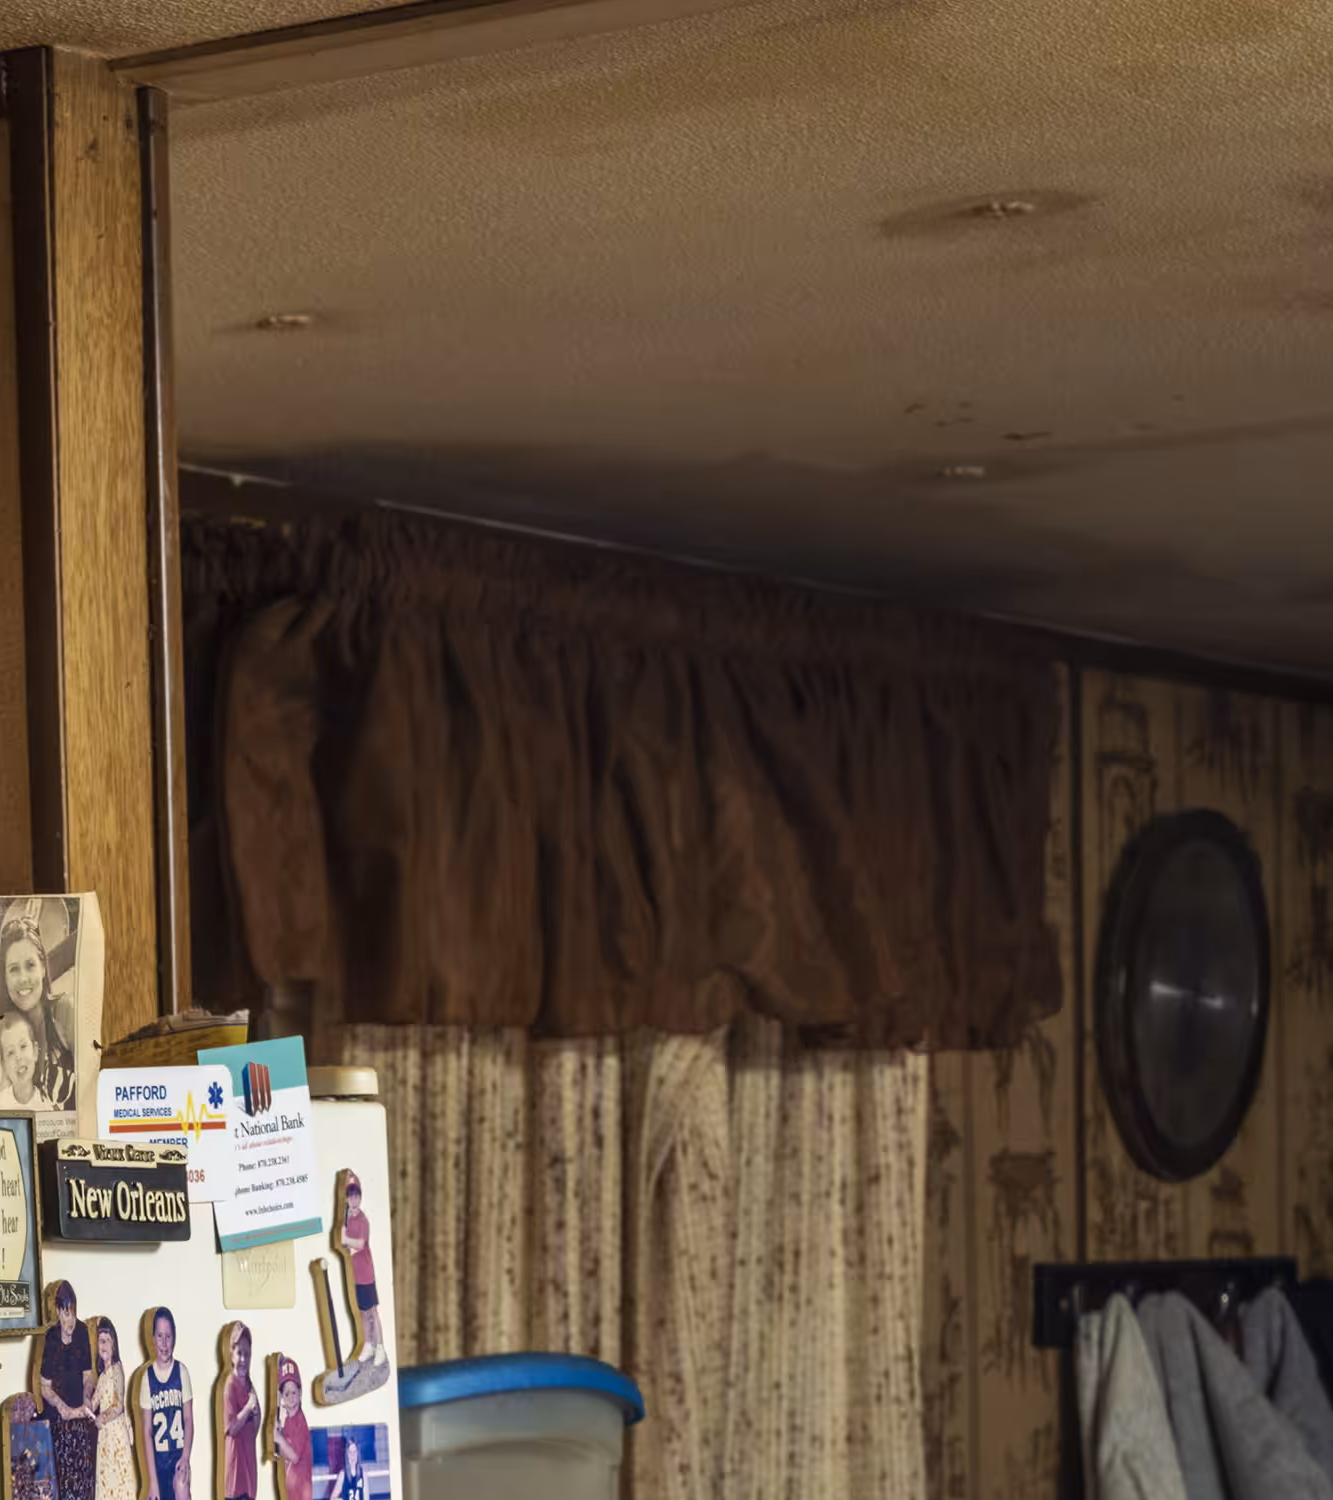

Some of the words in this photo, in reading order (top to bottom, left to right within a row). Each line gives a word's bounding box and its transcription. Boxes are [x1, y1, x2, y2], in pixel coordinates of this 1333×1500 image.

[115, 1085, 167, 1102] PAFFORD
[113, 1108, 141, 1118] MEDICAL
[142, 1107, 172, 1117] SERVICES
[241, 1117, 279, 1138] National
[281, 1112, 306, 1131] Bank
[0, 1171, 21, 1197] heart
[69, 1179, 113, 1219] New
[117, 1180, 187, 1222] Orleans
[1, 1209, 19, 1234] hear
[153, 1411, 184, 1452] 24
